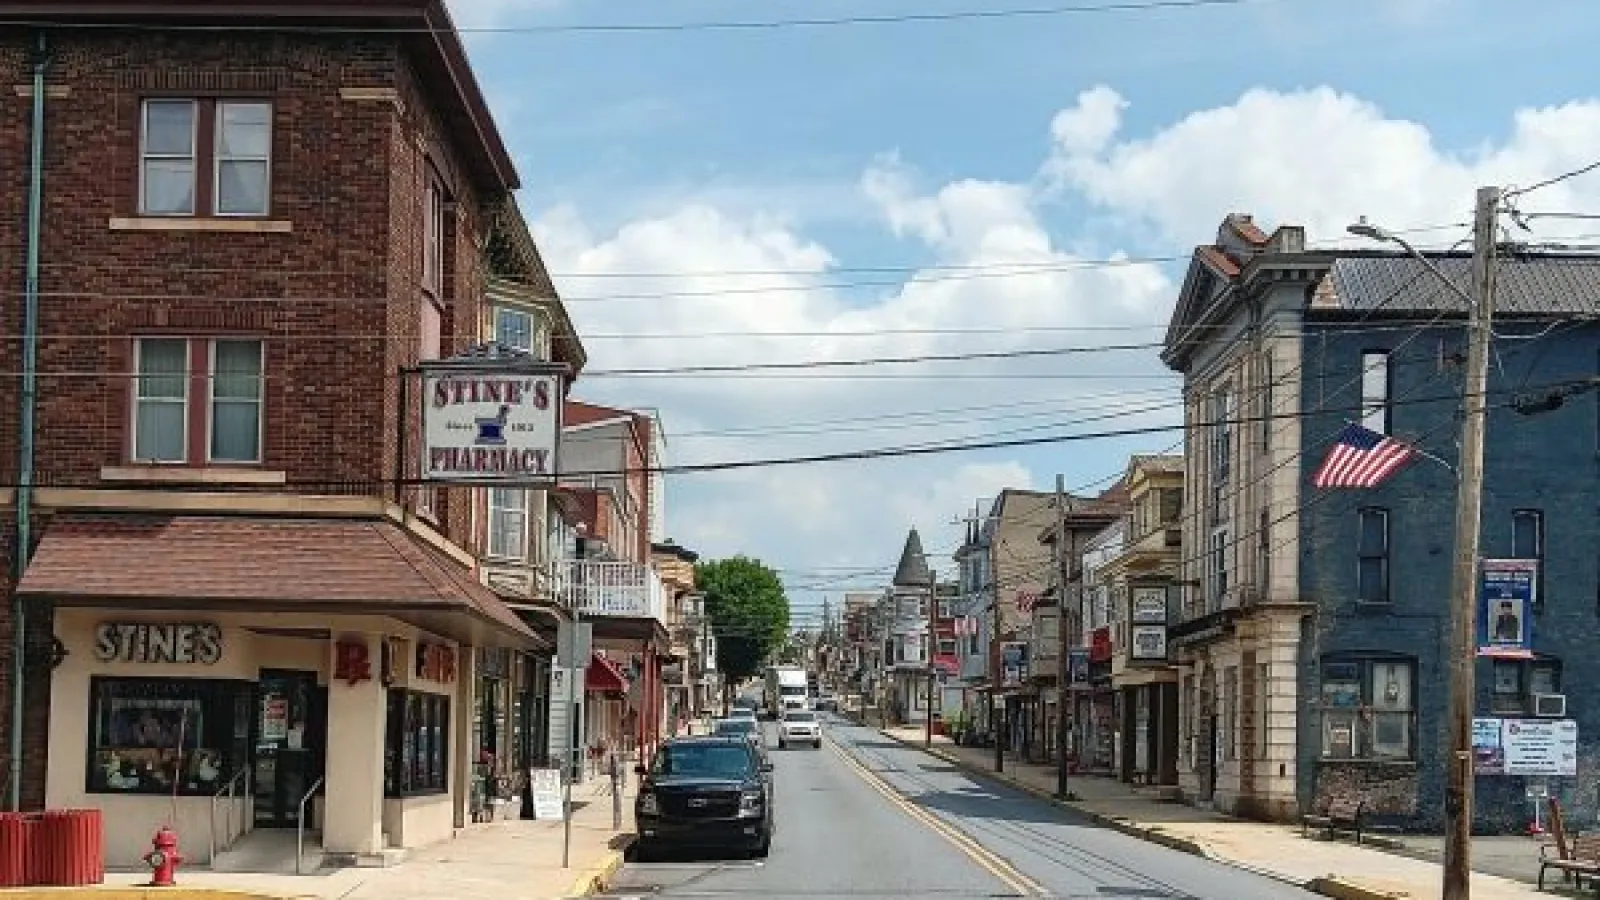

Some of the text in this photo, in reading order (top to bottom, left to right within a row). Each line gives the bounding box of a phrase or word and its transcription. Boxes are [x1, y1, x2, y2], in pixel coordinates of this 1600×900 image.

[433, 377, 549, 409] STINE'S
[429, 447, 550, 473] PHARMACY
[94, 621, 222, 664] STINE'S
